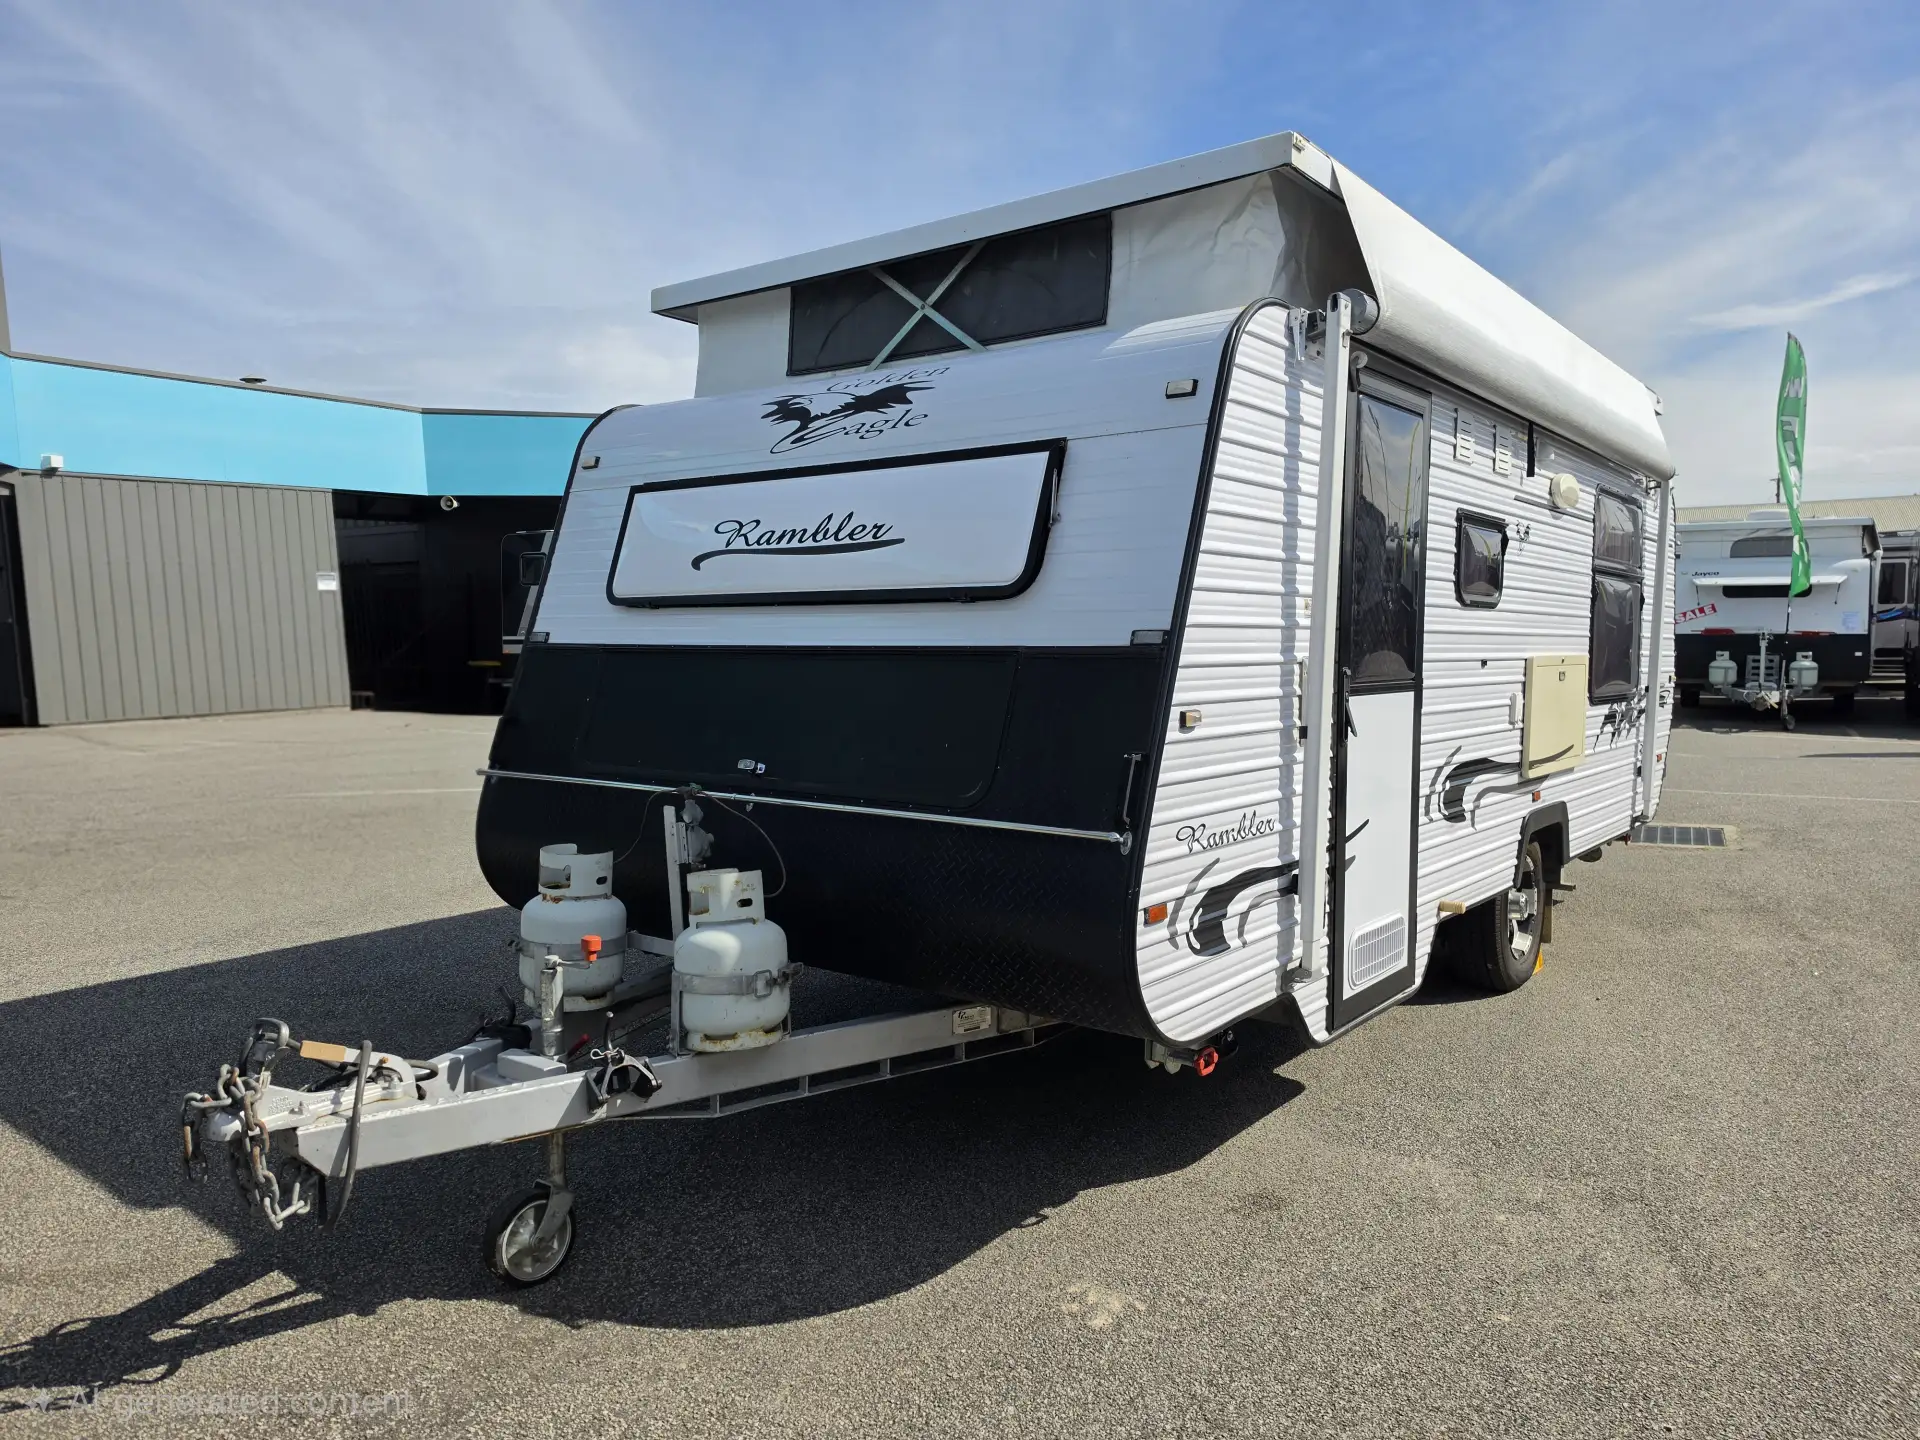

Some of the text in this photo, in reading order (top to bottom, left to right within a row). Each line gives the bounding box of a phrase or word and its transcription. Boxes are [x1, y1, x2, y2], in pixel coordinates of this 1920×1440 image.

[827, 366, 950, 392] Golden
[770, 409, 928, 454] Eagle
[714, 511, 894, 549] Rambler
[1675, 605, 1714, 623] SALE
[1175, 810, 1276, 853] Rambler
